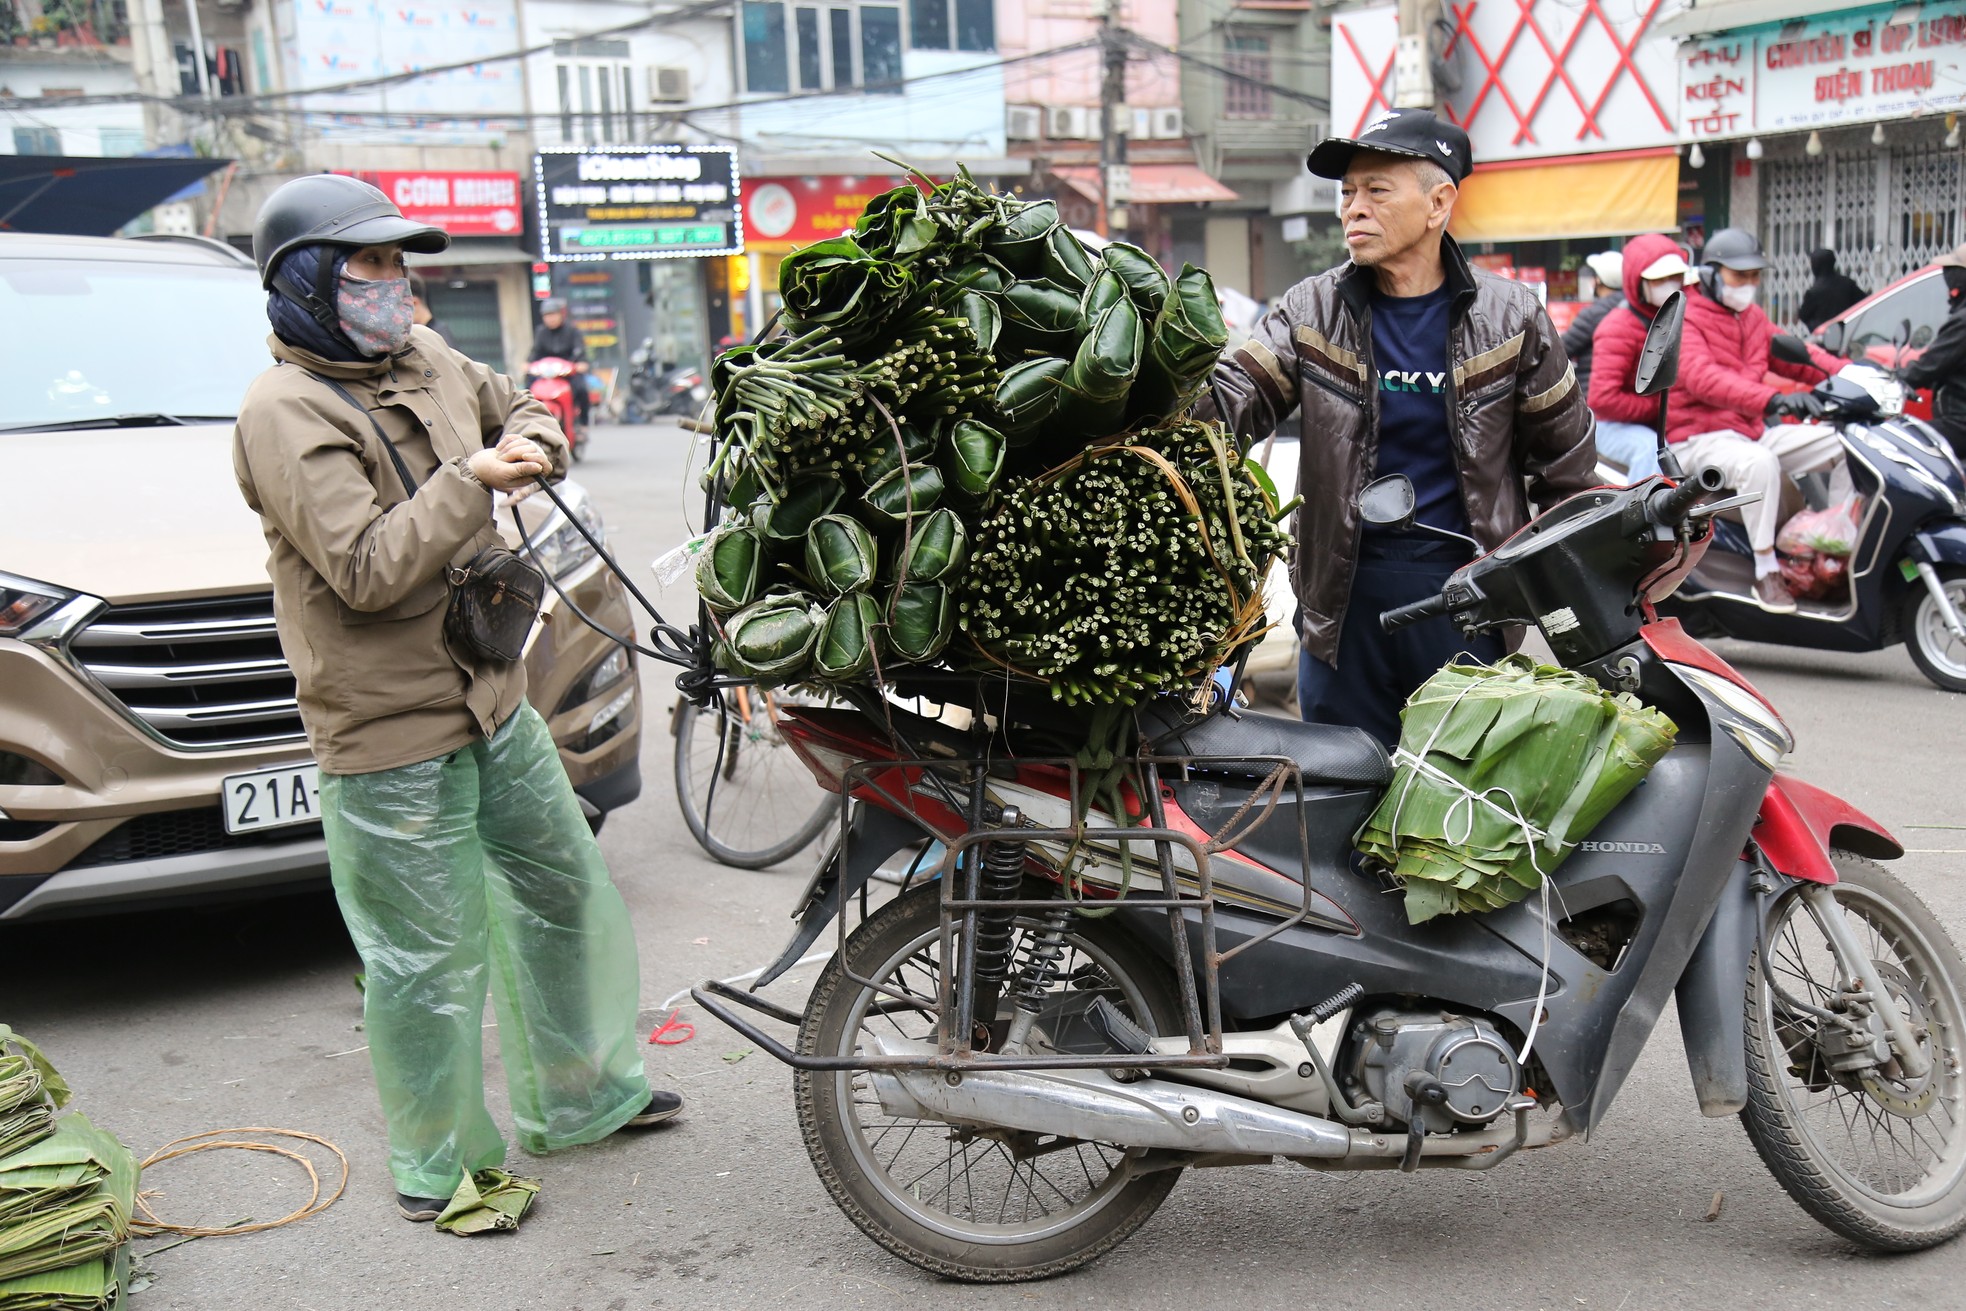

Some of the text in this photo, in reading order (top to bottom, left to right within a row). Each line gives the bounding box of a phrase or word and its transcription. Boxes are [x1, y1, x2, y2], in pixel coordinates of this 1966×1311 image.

[1871, 60, 1933, 95] THOẠI
[1425, 372, 1446, 393] Y
[1581, 841, 1667, 854] HONDA
